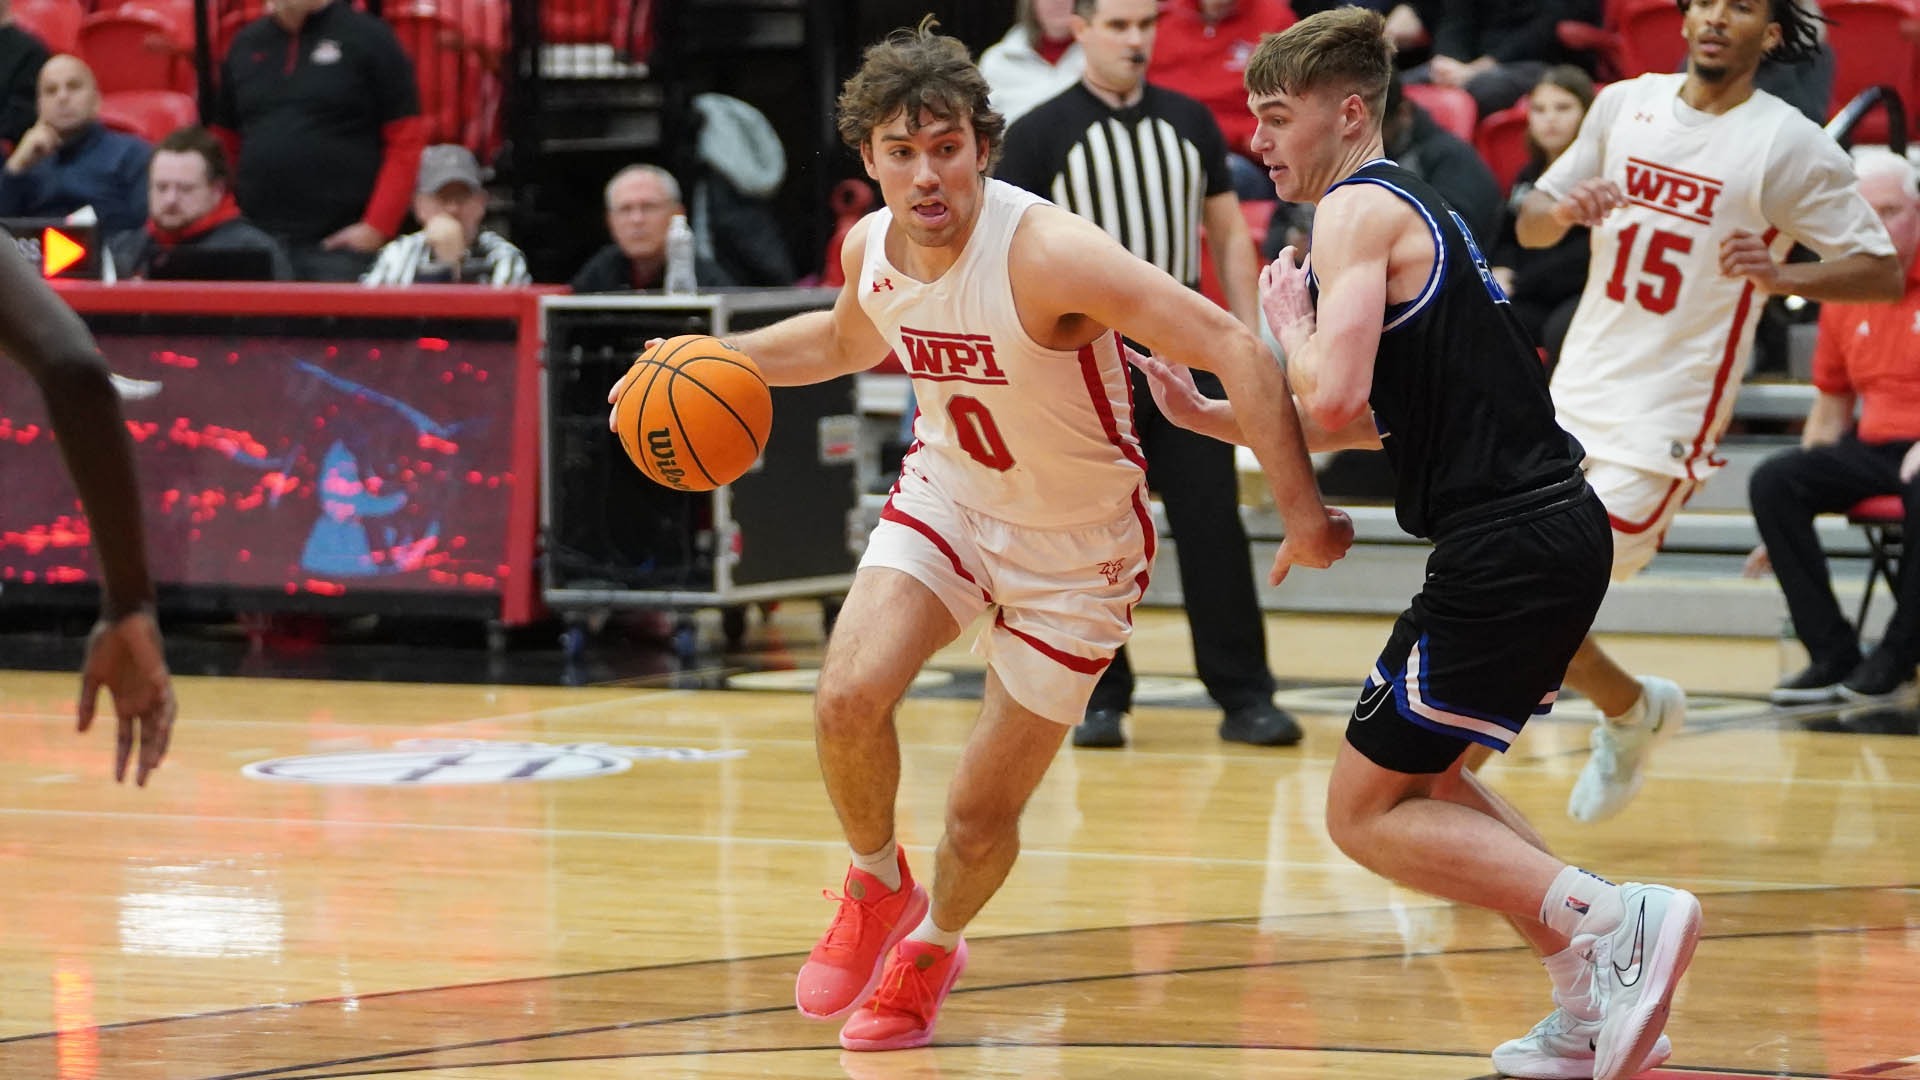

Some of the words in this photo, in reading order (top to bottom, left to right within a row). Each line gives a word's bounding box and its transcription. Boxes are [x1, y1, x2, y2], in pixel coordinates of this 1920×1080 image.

[1626, 165, 1721, 218] WPI
[1606, 222, 1693, 316] 15
[901, 335, 1006, 377] WPI
